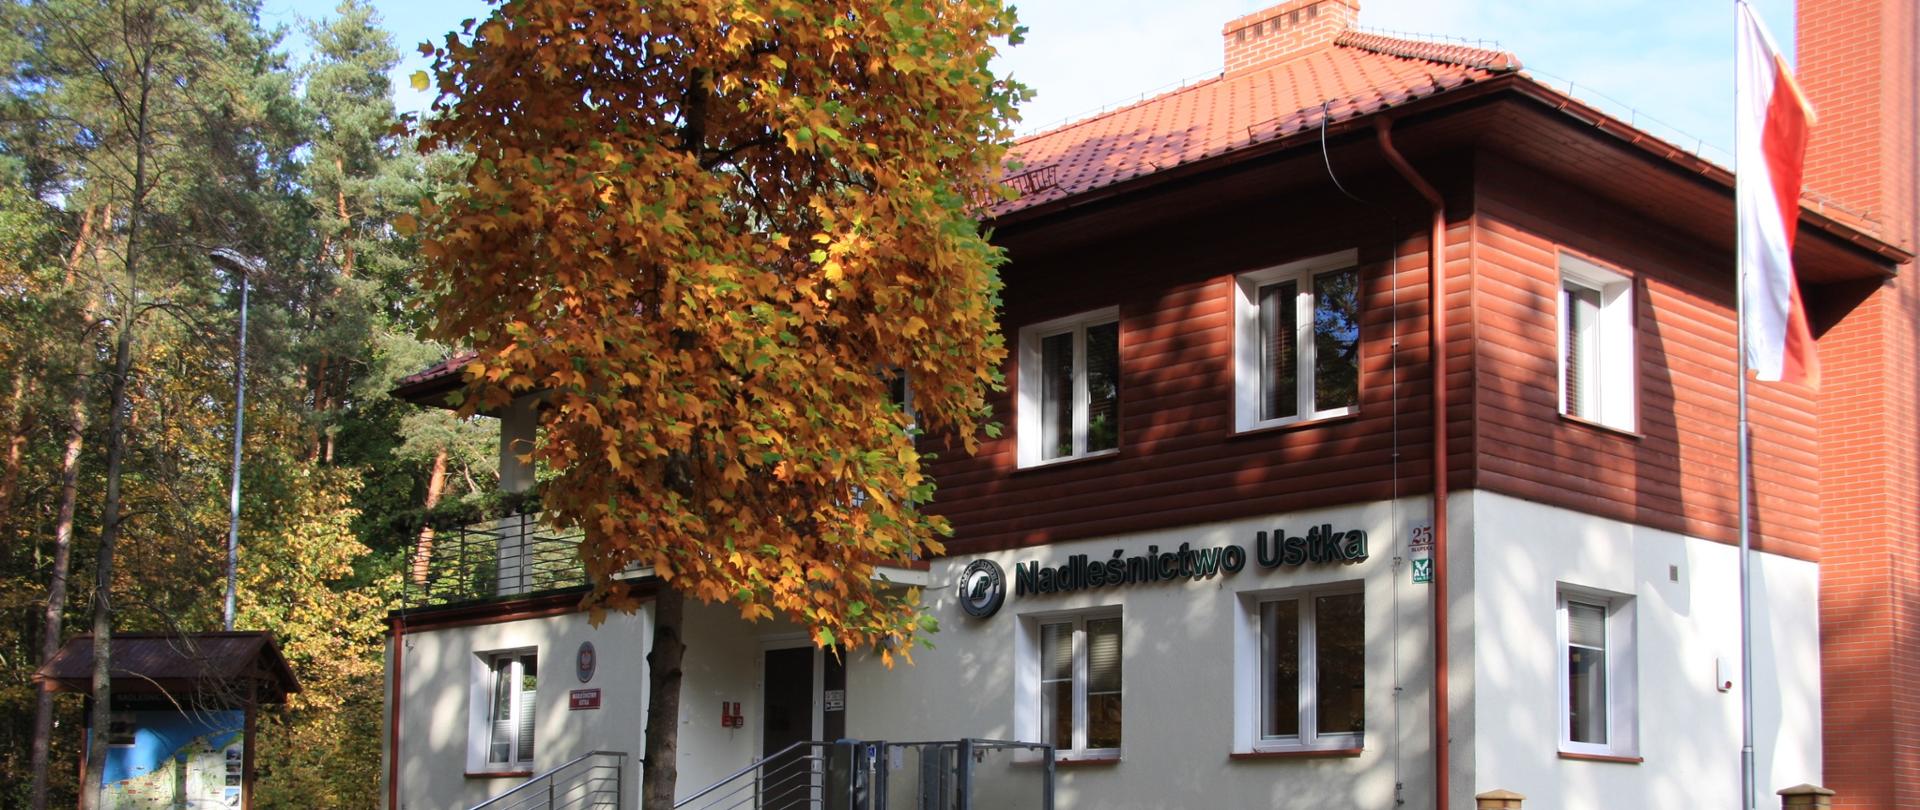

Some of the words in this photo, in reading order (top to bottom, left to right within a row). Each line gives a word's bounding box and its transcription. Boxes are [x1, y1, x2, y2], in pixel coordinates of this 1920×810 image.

[1412, 526, 1432, 545] 25
[1016, 541, 1246, 597] Nadleśnictwo
[1256, 523, 1369, 569] Ustka
